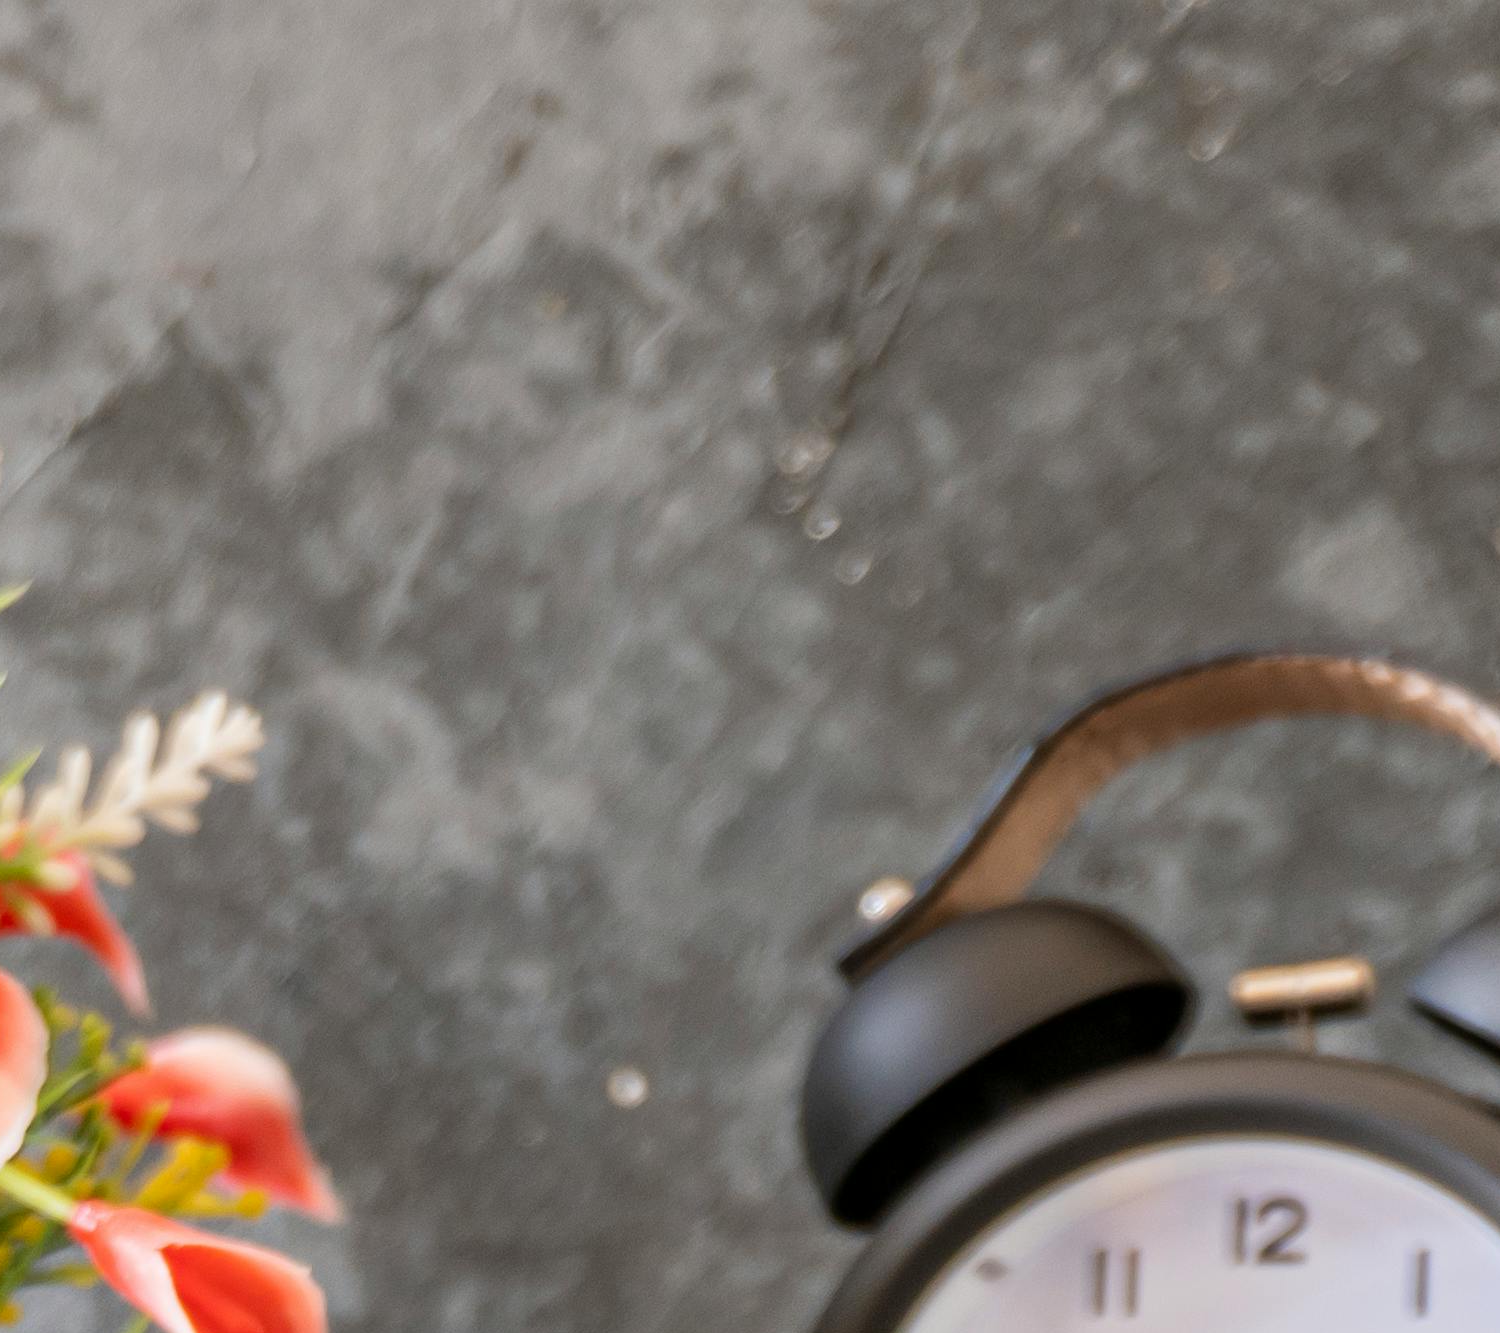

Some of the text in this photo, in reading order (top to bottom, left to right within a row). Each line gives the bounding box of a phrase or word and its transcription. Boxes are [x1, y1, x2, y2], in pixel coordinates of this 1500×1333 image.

[1233, 1195, 1308, 1266] 12
[1086, 1246, 1141, 1318] 11
[1410, 1246, 1431, 1317] 1
